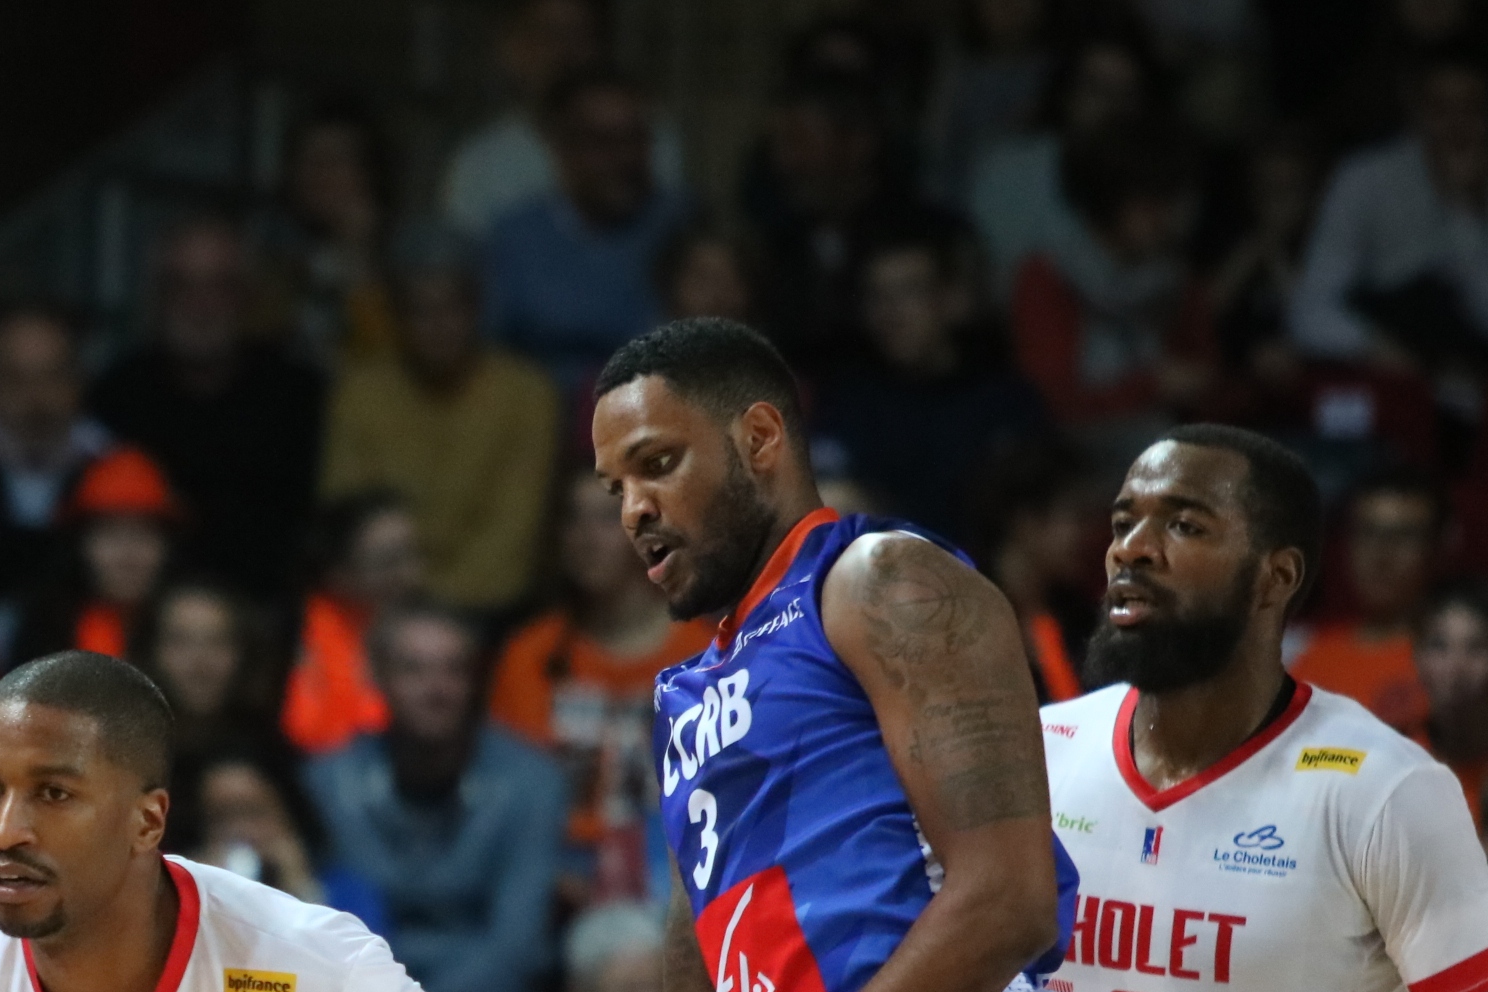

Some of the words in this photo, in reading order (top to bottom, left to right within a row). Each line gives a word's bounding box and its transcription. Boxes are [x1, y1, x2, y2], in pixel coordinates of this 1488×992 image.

[663, 668, 752, 798] CCRB
[1302, 749, 1359, 767] bpifrance
[687, 788, 719, 891] 3
[1213, 848, 1229, 861] Le
[1233, 850, 1297, 869] Choletais
